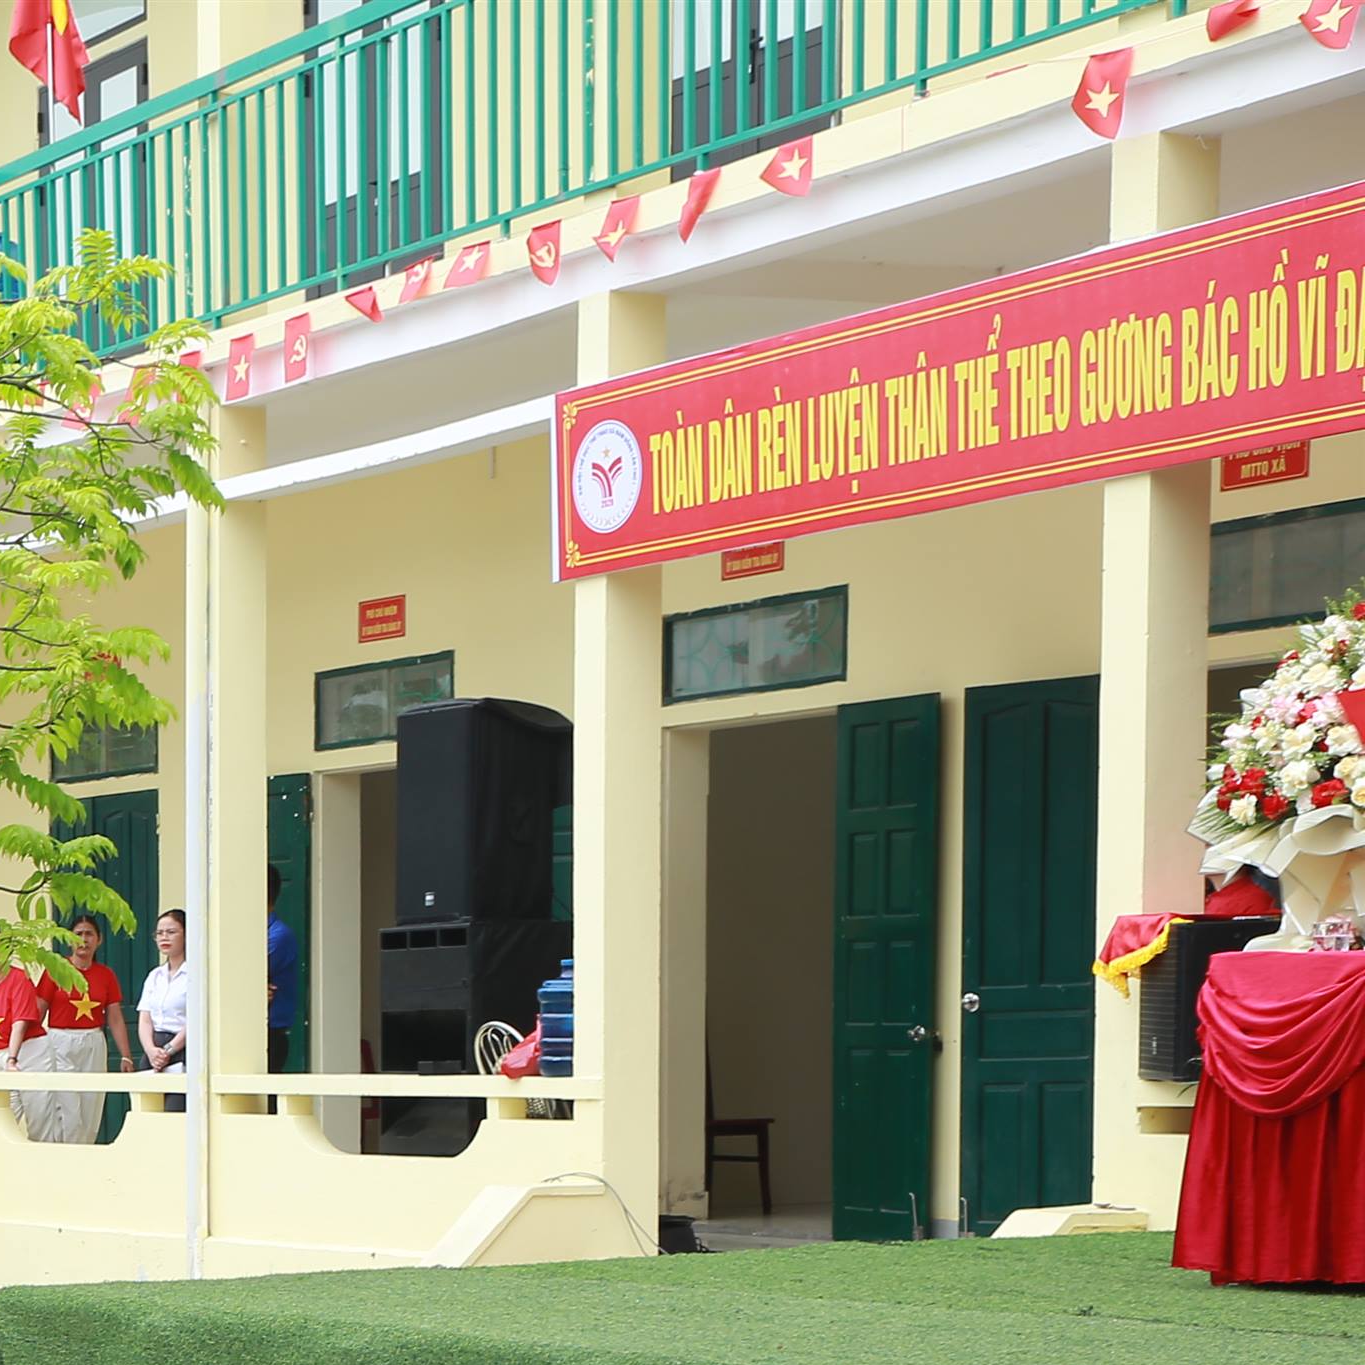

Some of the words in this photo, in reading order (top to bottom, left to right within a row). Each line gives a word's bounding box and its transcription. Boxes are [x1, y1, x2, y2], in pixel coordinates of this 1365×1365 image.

[649, 410, 703, 515] TOÀN
[708, 398, 752, 503] DÂN
[757, 386, 802, 493] RÈN
[807, 369, 879, 494] LUYỆN
[884, 352, 948, 466] THÂN
[954, 313, 1002, 452] THỂ
[1006, 336, 1071, 441] THEO
[1079, 312, 1172, 427] GƯƠNG
[1181, 279, 1239, 406] BÁC
[1248, 248, 1288, 391] HỒ
[1297, 253, 1329, 380] VĨ
[1240, 461, 1269, 479] MTTQ
